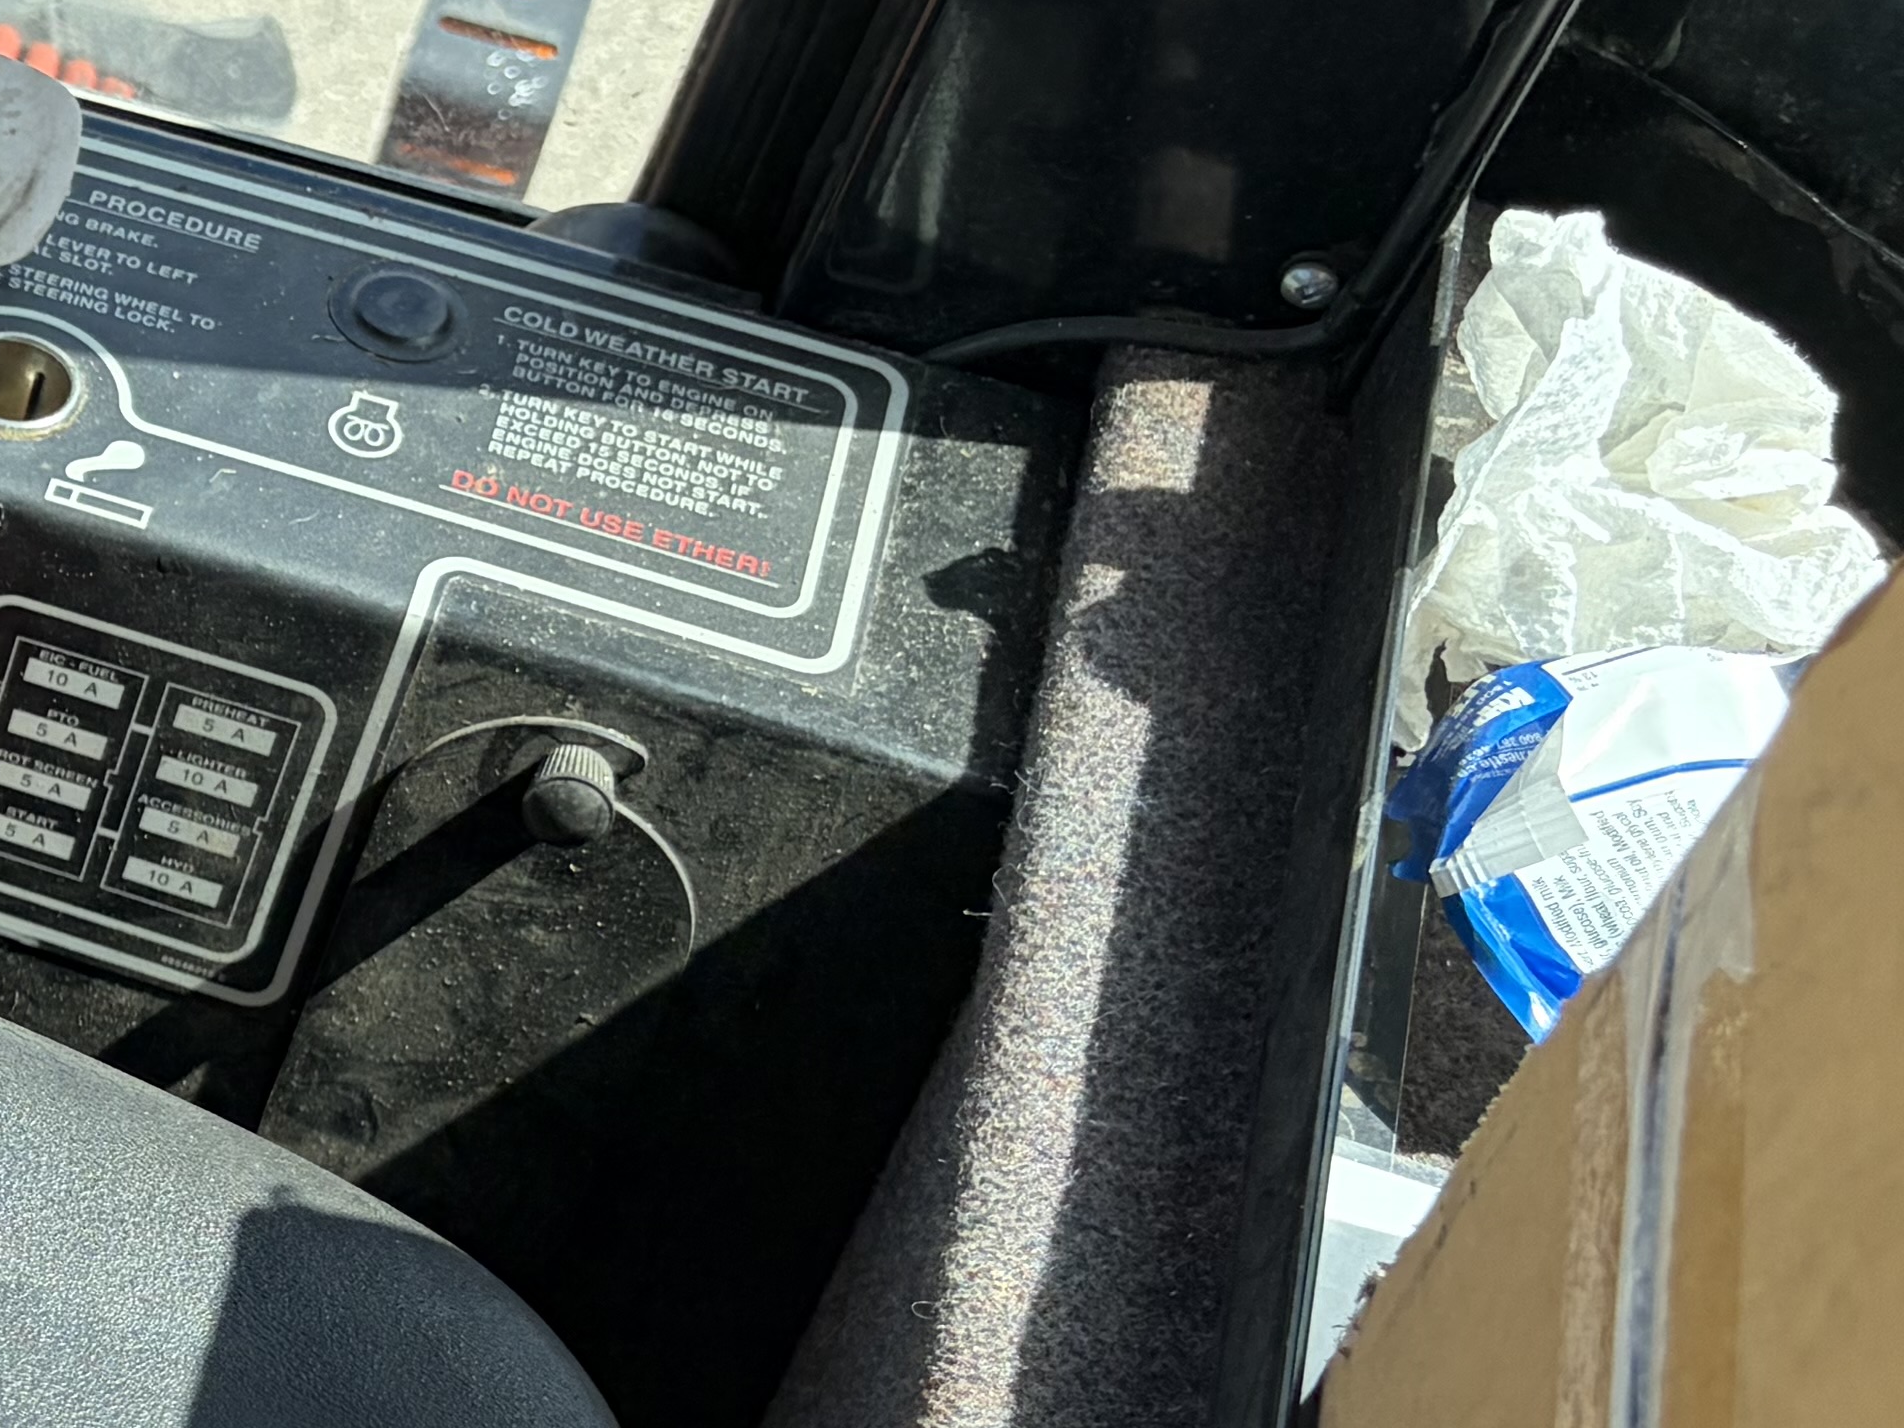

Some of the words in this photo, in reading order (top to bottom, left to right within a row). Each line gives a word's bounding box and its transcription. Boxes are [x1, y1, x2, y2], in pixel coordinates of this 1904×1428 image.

[85, 218, 159, 248] BRAKE.
[89, 190, 263, 250] PROCEDURE
[46, 233, 112, 261] LEVER
[116, 252, 142, 269] TO
[146, 261, 198, 285] LEFT
[59, 250, 114, 276] SLOT.
[8, 263, 109, 301] STEERING
[114, 291, 183, 323] WHEEL
[190, 313, 216, 330] TO
[8, 277, 109, 314] STEERING
[114, 306, 175, 334] LOCK.
[503, 306, 579, 338] COLD
[584, 327, 714, 377] WEATHER
[722, 367, 809, 403] START
[517, 339, 573, 364] TURN
[579, 357, 620, 377] KEY
[626, 371, 651, 387] TO
[658, 379, 737, 411] ENGINE
[743, 404, 774, 422] ON
[500, 402, 595, 439] HOLDING
[697, 460, 742, 481] NOT
[746, 473, 773, 491] TO
[501, 389, 558, 415] TURN
[564, 406, 606, 428] KEY
[610, 419, 638, 437] TO
[643, 430, 713, 458] START
[716, 450, 783, 481] WHILE
[492, 428, 572, 460] ENGINE
[577, 453, 637, 479] DOES
[642, 472, 687, 493] NOT
[496, 415, 581, 449] EXCEED
[730, 483, 751, 496] IF
[488, 440, 572, 473] REPEAT
[576, 467, 715, 518] PROCEDURE.
[451, 469, 500, 497] DO
[506, 486, 574, 518] NOT
[580, 507, 644, 541] USE
[48, 669, 68, 687] 10
[84, 682, 97, 697] A
[47, 708, 80, 727] PTO
[192, 696, 270, 727] PREHEAT
[36, 722, 48, 737] 5
[64, 732, 77, 747] A
[202, 718, 214, 732] 5
[231, 728, 245, 743] A
[34, 759, 99, 788] SCREEN
[177, 749, 247, 779] LIGHTER
[20, 773, 32, 788] 5
[48, 783, 61, 798] A
[183, 768, 204, 785] 10
[214, 779, 228, 794] A
[6, 806, 59, 830] START
[137, 793, 251, 837] ACCESSORIES
[4, 823, 17, 838] 5
[32, 832, 45, 848] A
[196, 830, 209, 845] A
[149, 870, 170, 886] 10
[179, 881, 193, 894] A
